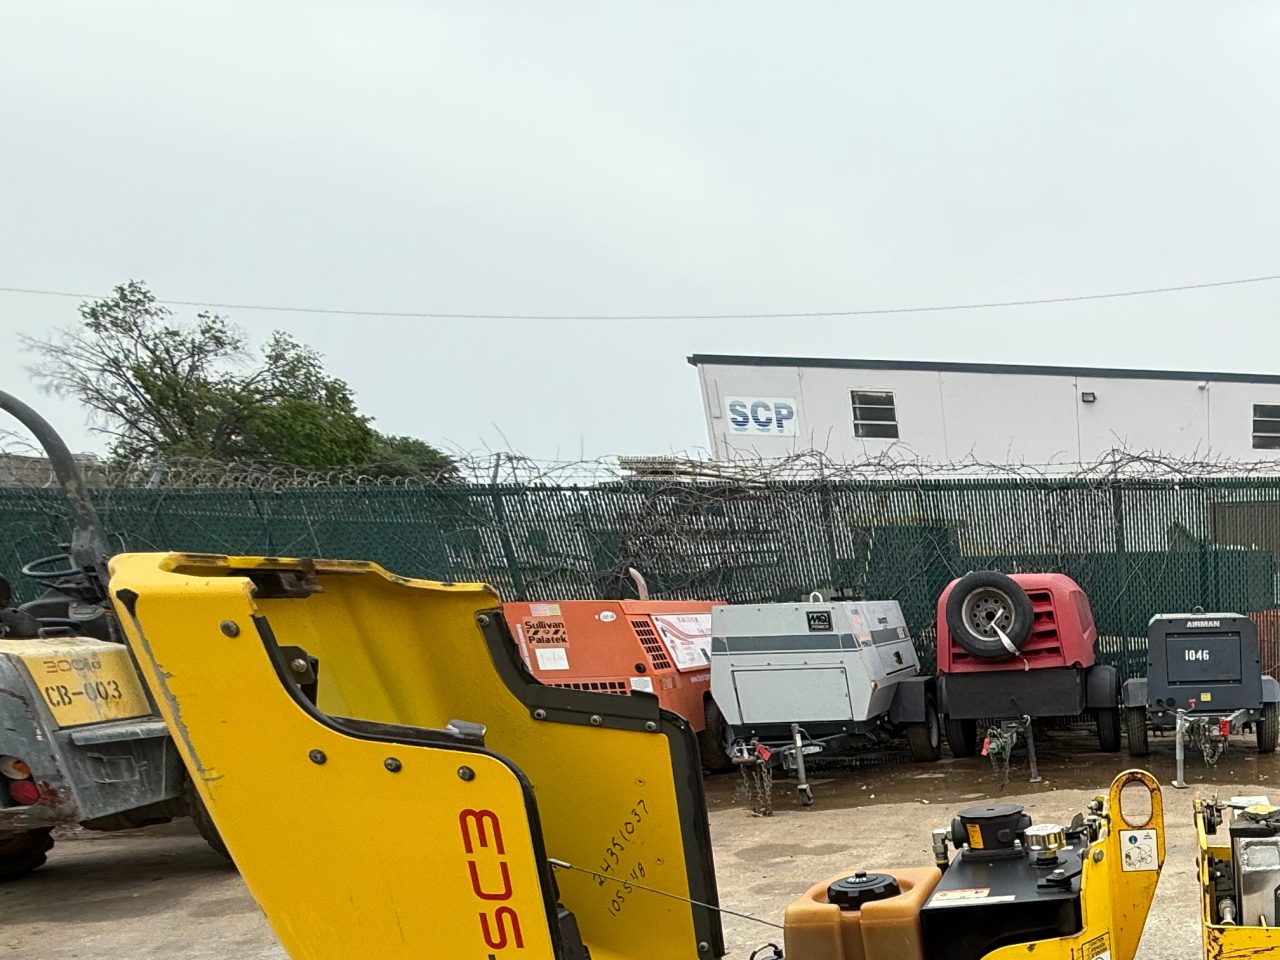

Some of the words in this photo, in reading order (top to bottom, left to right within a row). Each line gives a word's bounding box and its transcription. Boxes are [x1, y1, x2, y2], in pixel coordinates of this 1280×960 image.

[729, 400, 794, 429] SCP
[524, 621, 565, 630] Sullivan
[1186, 620, 1220, 628] AIRMAN
[528, 635, 568, 644] Palatek
[1184, 649, 1210, 661] 1046
[45, 680, 122, 707] CB-003
